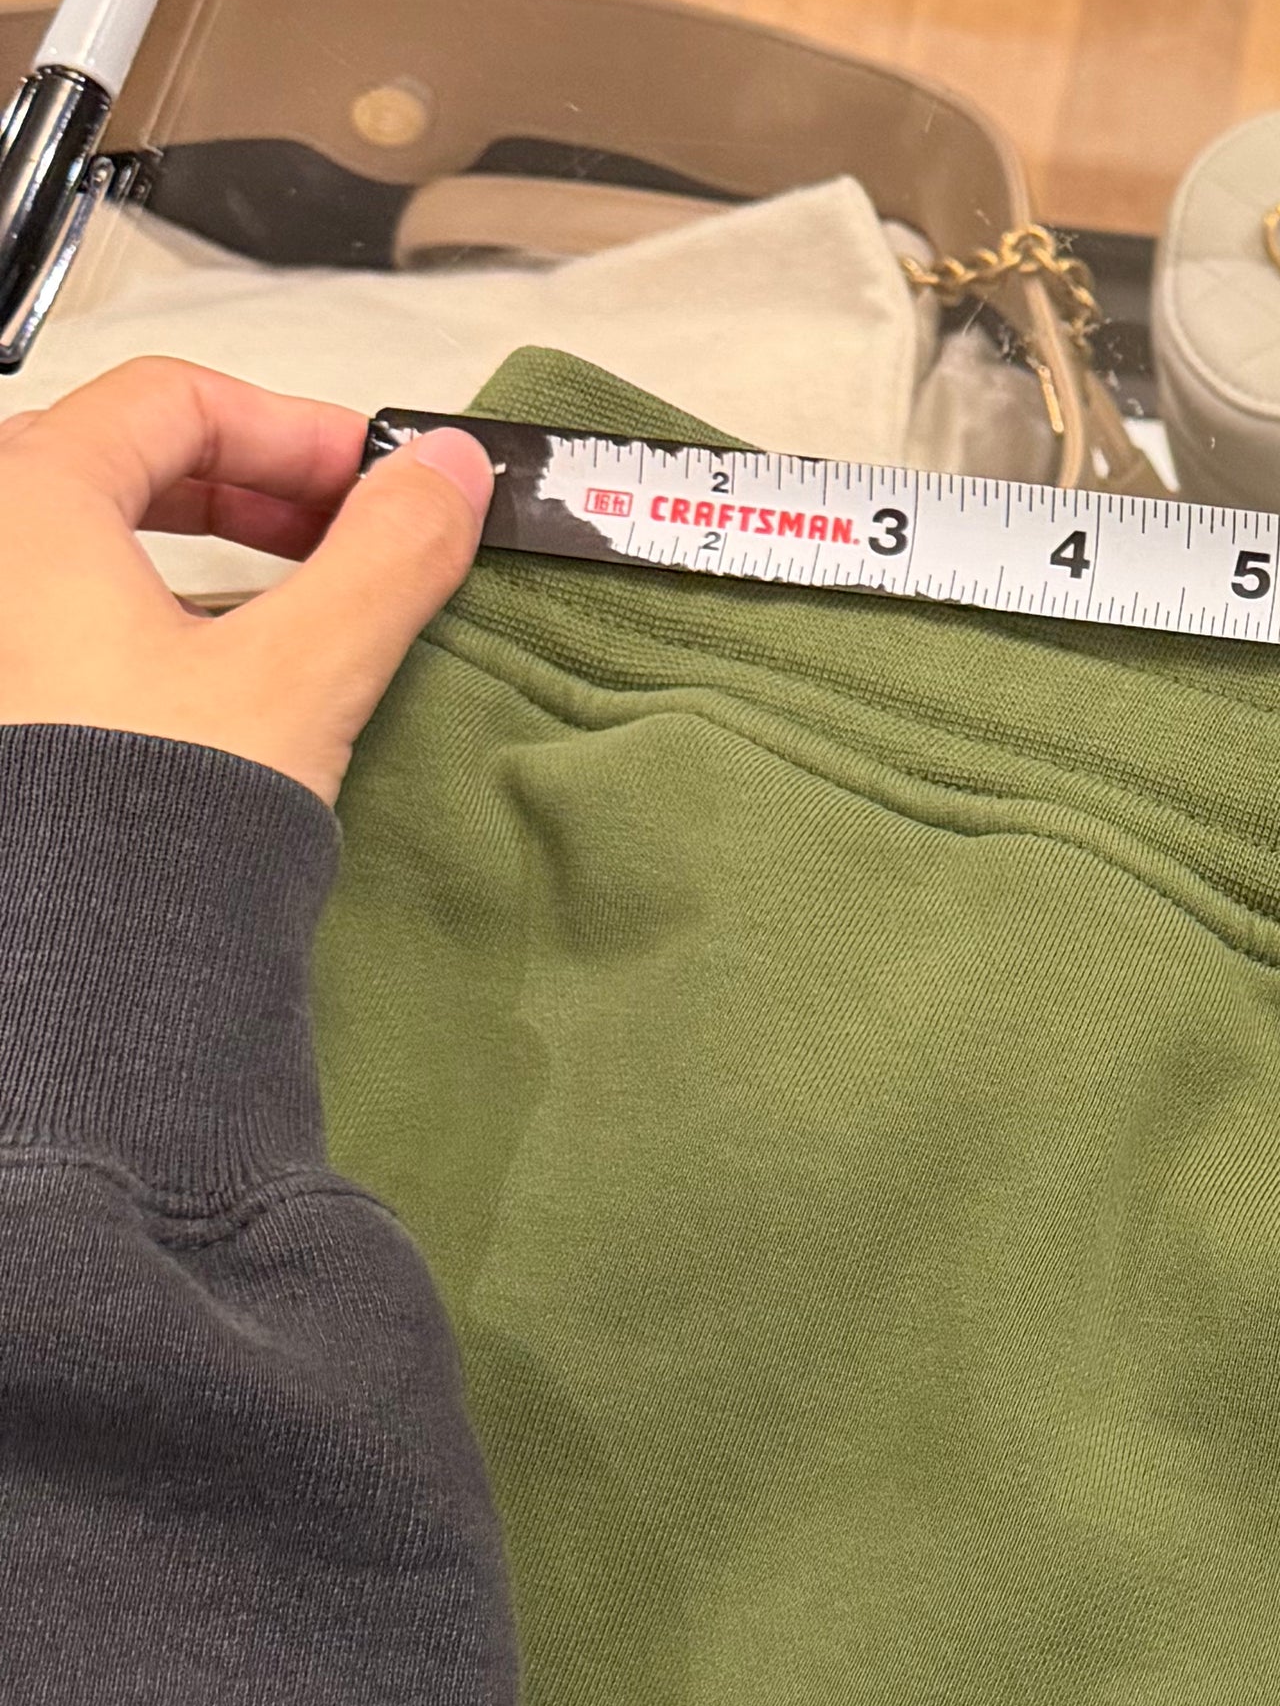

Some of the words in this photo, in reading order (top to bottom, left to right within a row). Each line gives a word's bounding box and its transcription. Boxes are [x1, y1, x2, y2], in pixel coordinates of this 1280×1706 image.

[711, 471, 732, 494] 2
[700, 531, 722, 551] 2
[868, 508, 909, 556] 3
[1049, 530, 1091, 579] 4
[1231, 551, 1271, 599] 5
